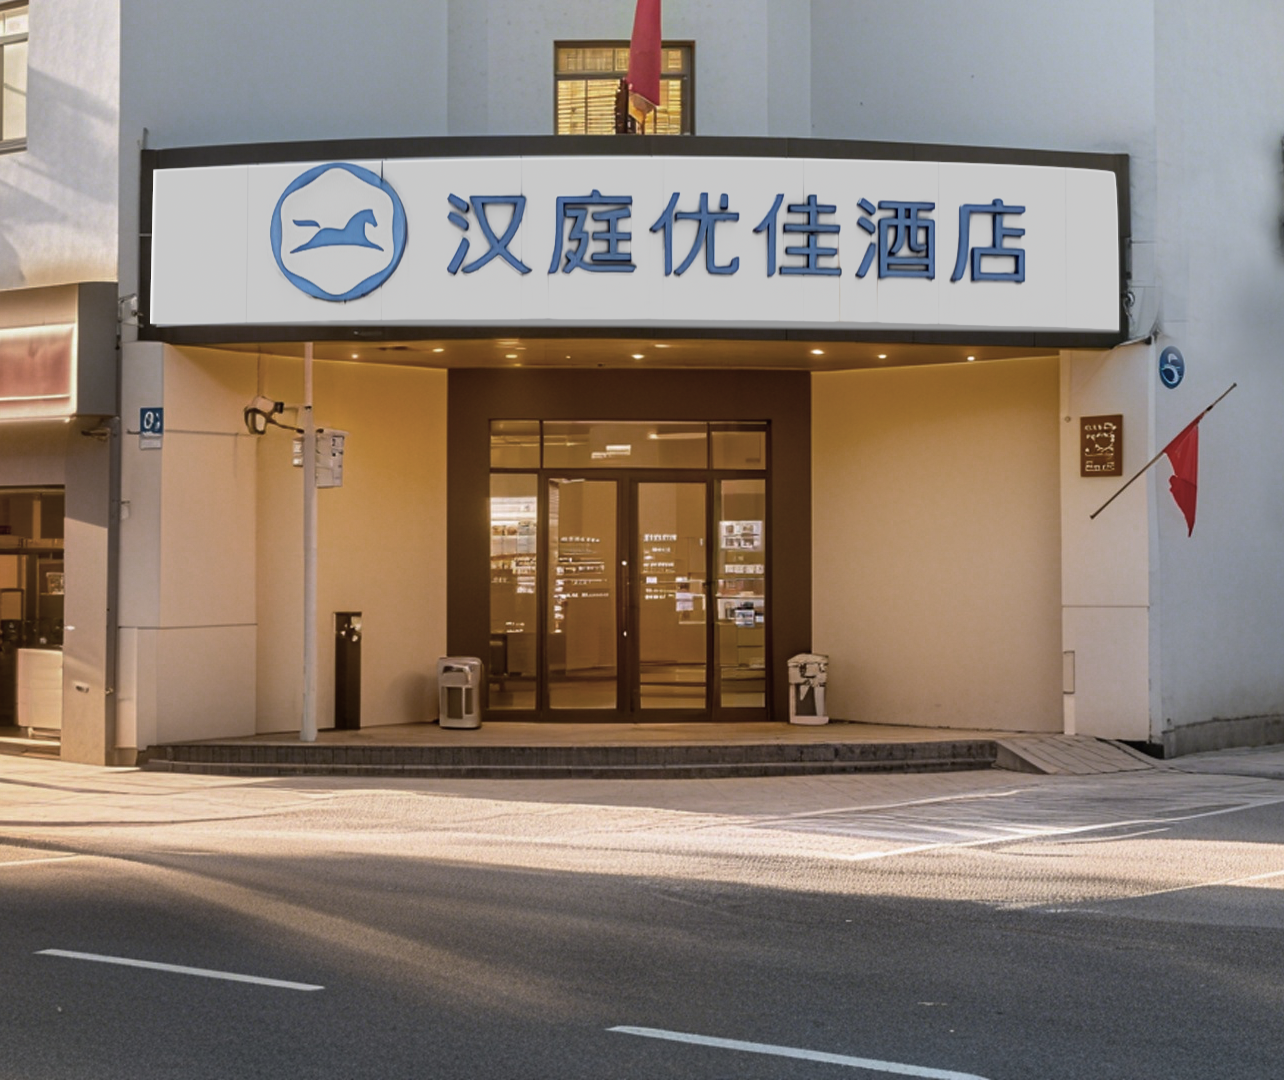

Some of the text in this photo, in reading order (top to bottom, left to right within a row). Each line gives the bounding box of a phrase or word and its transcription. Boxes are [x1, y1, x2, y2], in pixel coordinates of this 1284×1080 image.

[446, 189, 1026, 283] 汉庭优佳酒店
